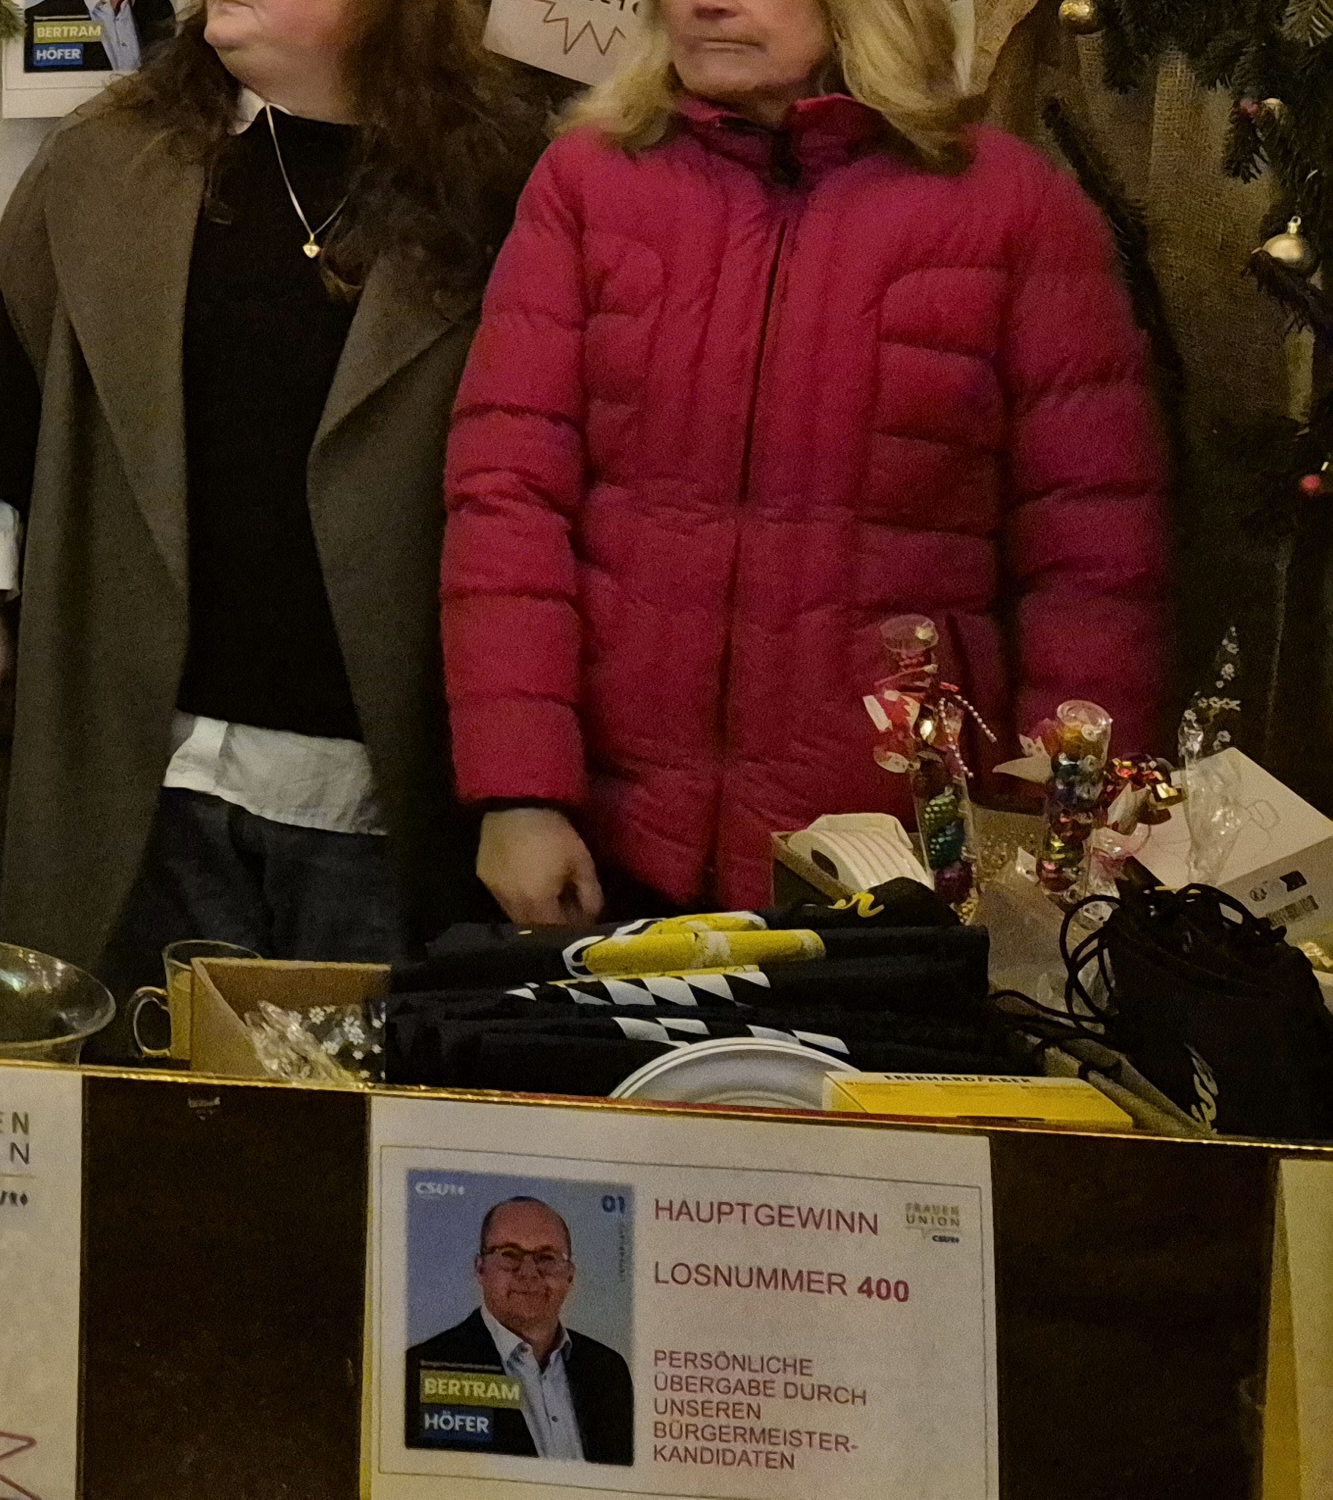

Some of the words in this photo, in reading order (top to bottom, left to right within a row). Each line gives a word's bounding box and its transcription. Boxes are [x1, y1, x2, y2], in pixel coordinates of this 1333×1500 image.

[36, 25, 102, 38] BERTRAM
[36, 47, 81, 60] HÖFER
[601, 1195, 626, 1214] 01
[654, 1199, 879, 1236] HAUPTGEWINN
[906, 1213, 960, 1227] UNION
[654, 1261, 848, 1296] LOSNUMMER
[857, 1276, 910, 1303] 400
[654, 1350, 814, 1377] PERSÖNLICHE
[424, 1378, 520, 1400] BERTRAM
[654, 1371, 776, 1398] ÜBERGABE
[784, 1381, 867, 1406] DURCH
[424, 1410, 490, 1434] HÖFER
[654, 1399, 761, 1421] UNSEREN
[653, 1419, 859, 1453] BÜRGERMEISTER-
[653, 1444, 795, 1470] KANDIDATEN
